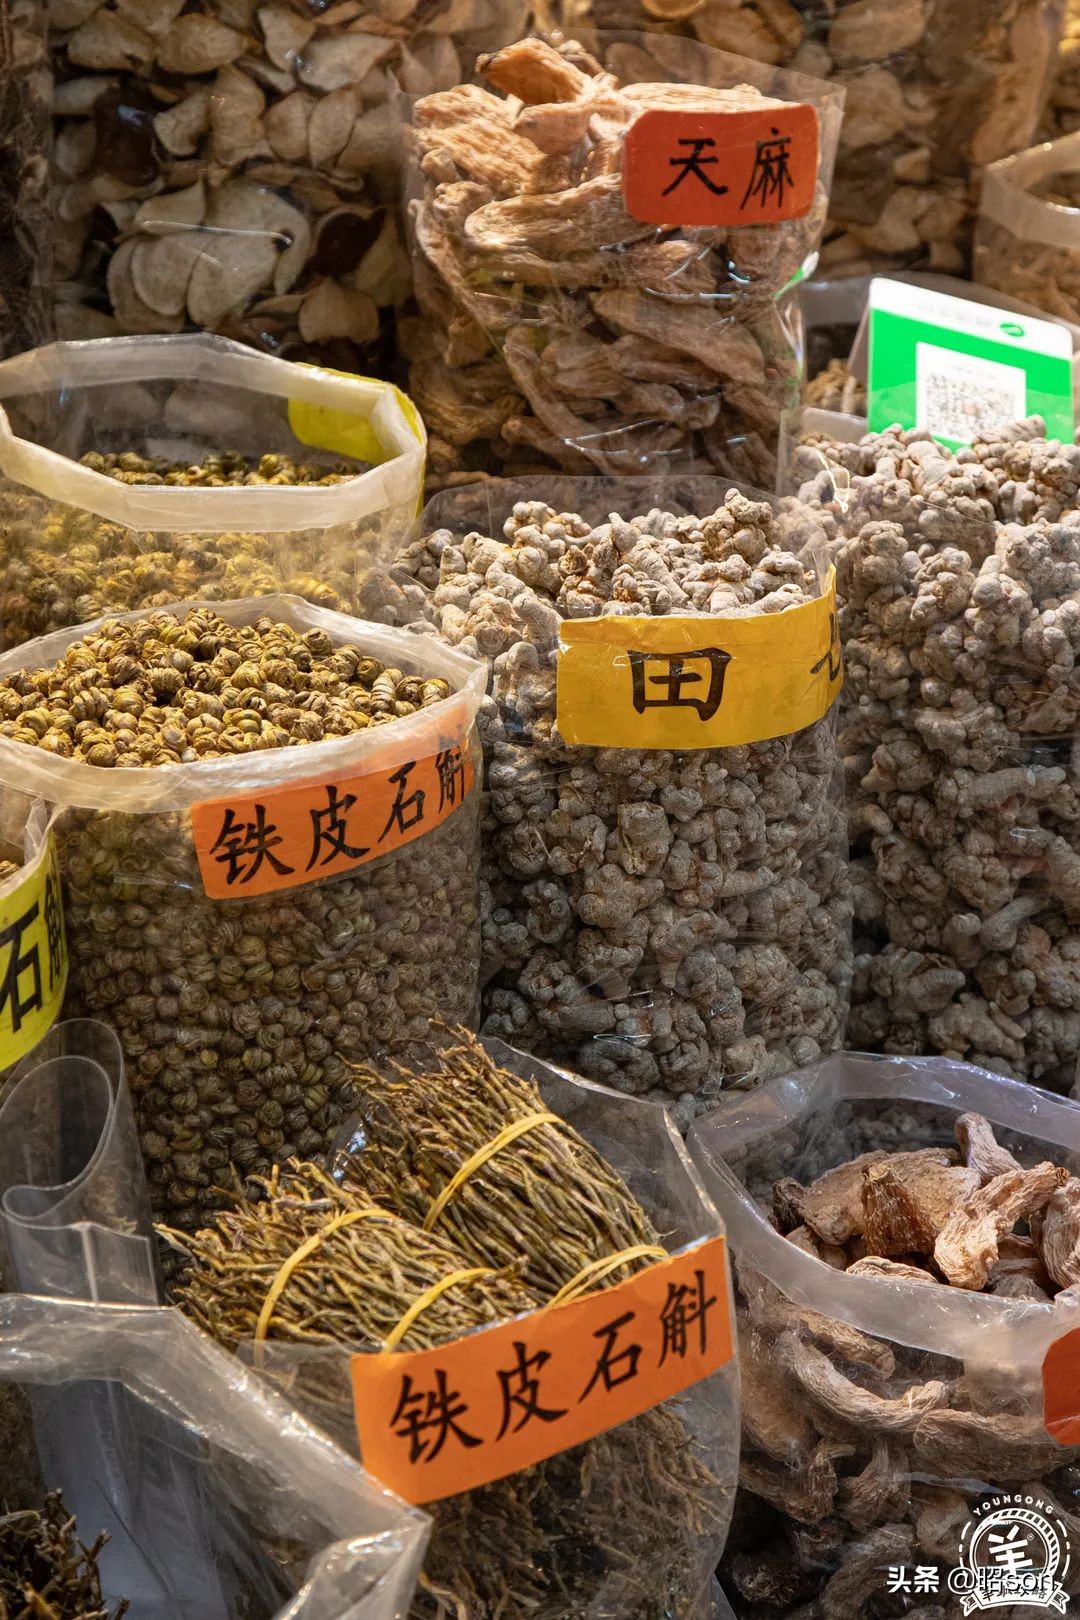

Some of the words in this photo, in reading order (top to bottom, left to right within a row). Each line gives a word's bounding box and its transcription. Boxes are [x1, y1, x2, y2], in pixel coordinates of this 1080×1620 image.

[661, 127, 794, 210] 天麻
[209, 736, 466, 886] 铁皮石斛
[389, 1270, 717, 1463] 铁皮石斛
